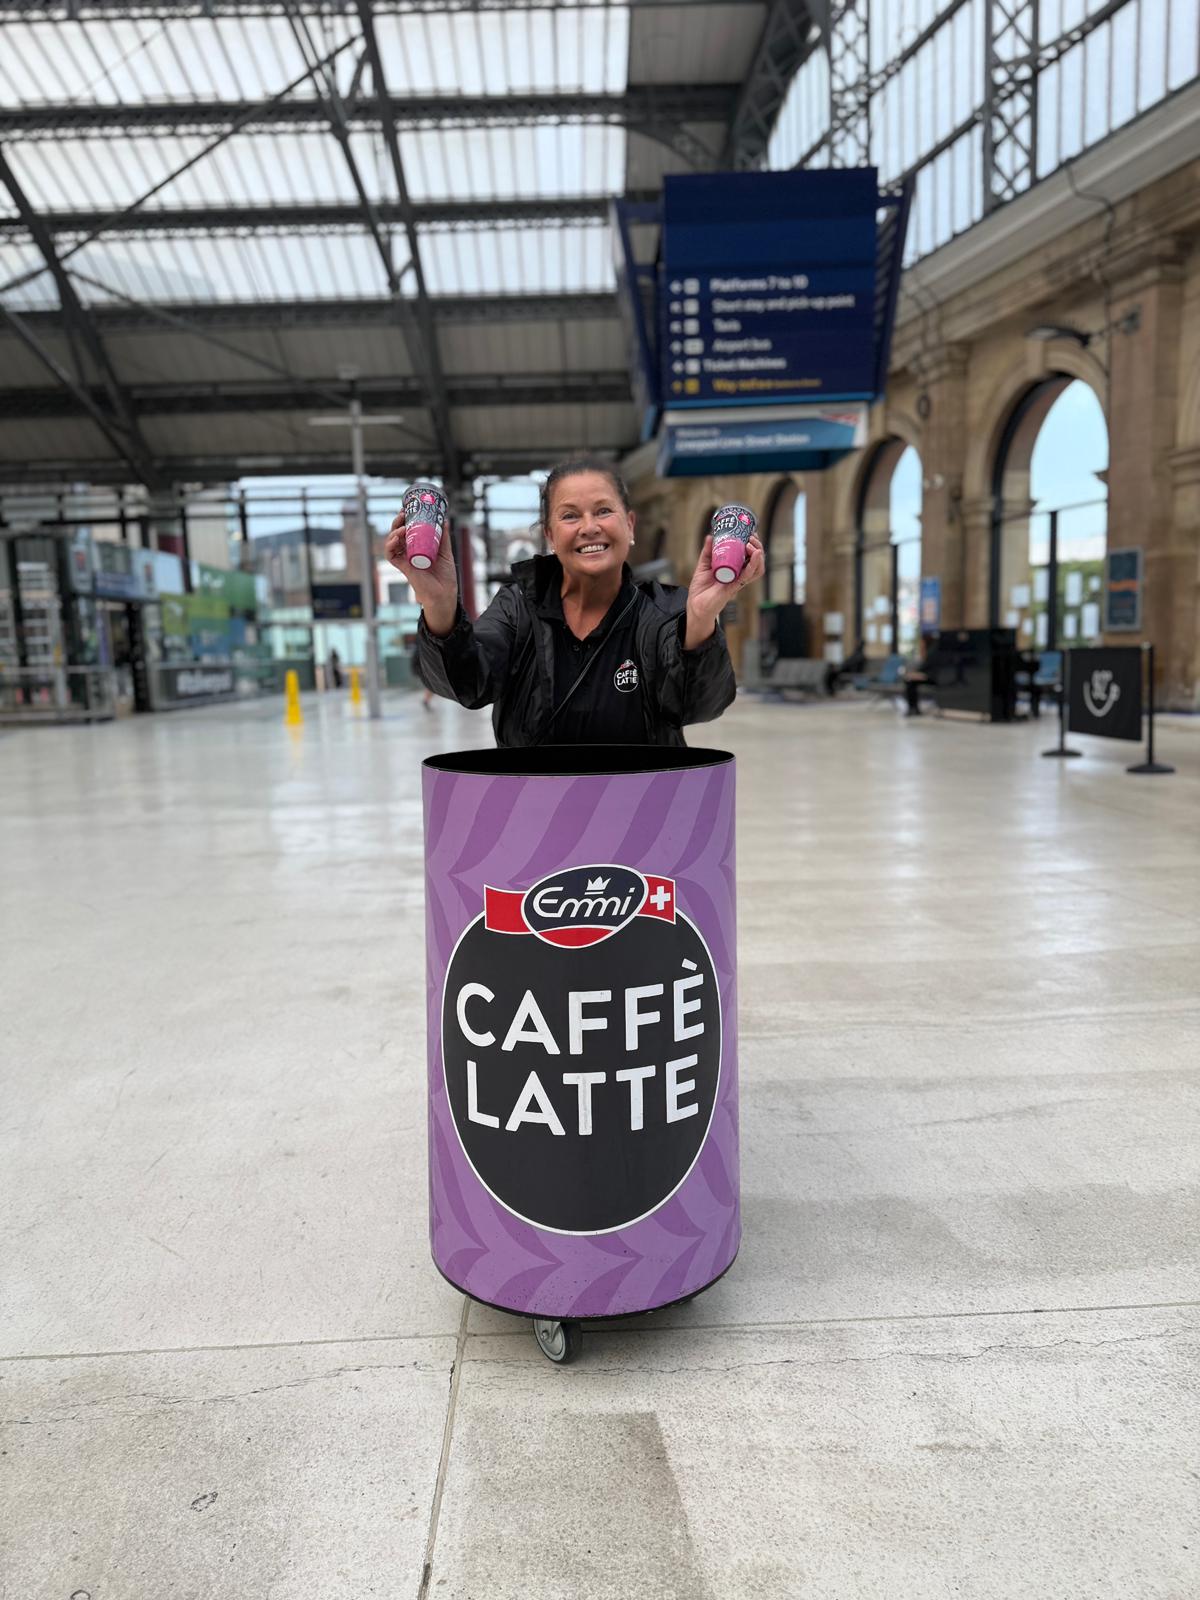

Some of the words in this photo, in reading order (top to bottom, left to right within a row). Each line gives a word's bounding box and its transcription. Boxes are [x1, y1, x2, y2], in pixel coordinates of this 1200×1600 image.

[710, 277, 767, 292] Platforms
[777, 277, 792, 289] to
[766, 296, 785, 310] and
[825, 294, 855, 310] point
[737, 357, 786, 370] Machines
[617, 676, 637, 686] LATTE
[532, 886, 635, 918] Emmi
[456, 958, 705, 1055] CAFFÈ
[466, 1053, 699, 1136] LATTE
